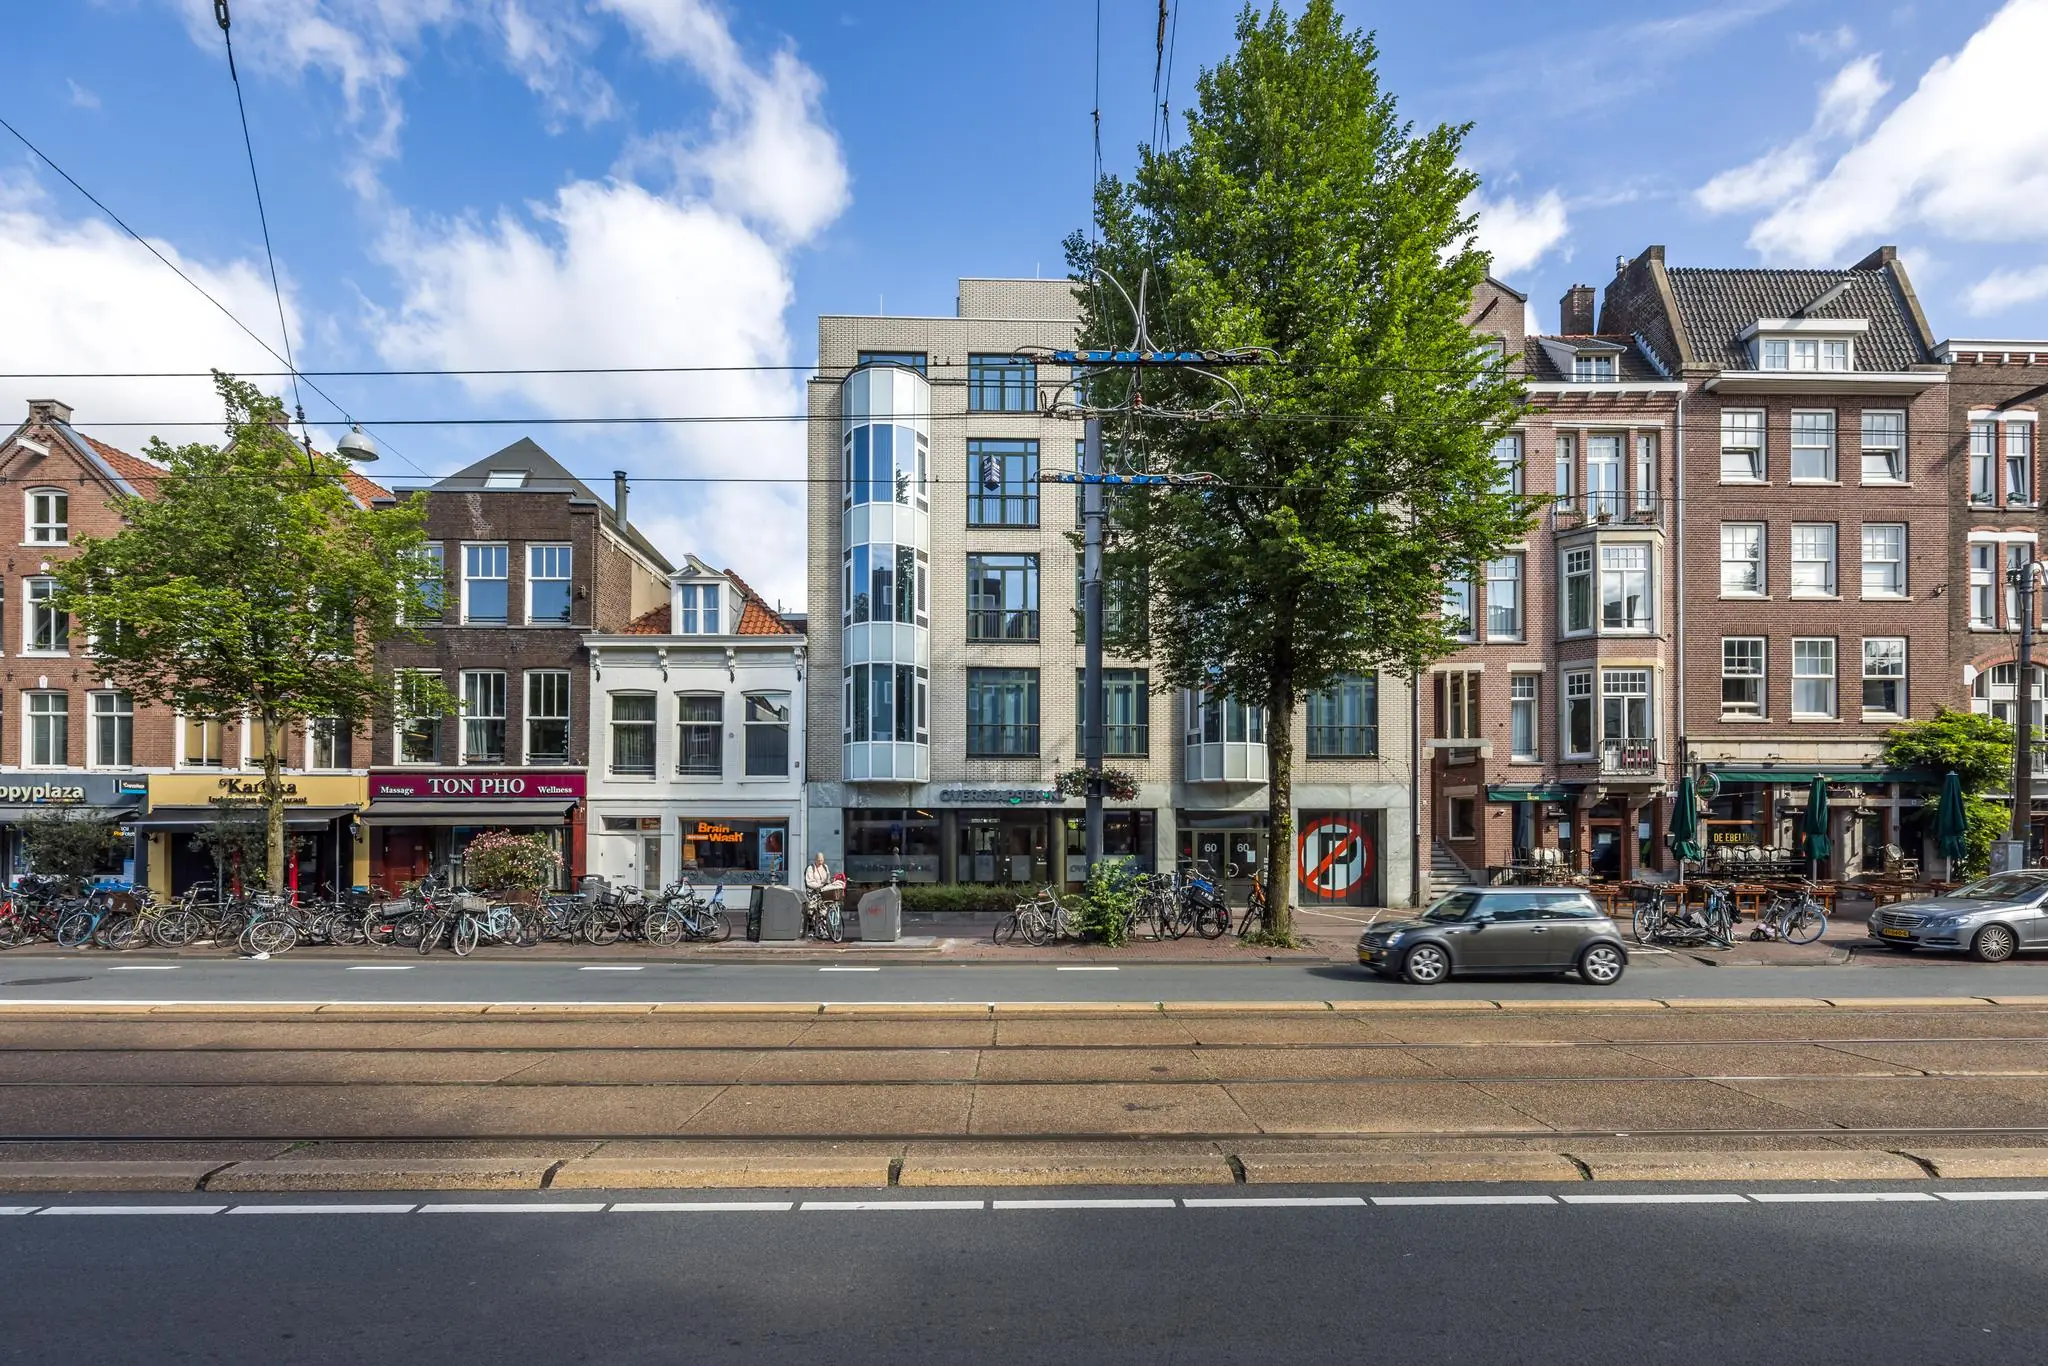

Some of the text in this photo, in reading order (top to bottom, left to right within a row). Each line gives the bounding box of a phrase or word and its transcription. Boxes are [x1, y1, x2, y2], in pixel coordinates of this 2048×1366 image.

[380, 786, 414, 795] Massage
[428, 778, 525, 794] TON PHO
[537, 786, 573, 794] Wellness
[697, 821, 730, 833] Brain
[709, 832, 743, 842] Wash
[1204, 843, 1217, 852] 60
[1237, 843, 1250, 852] 60
